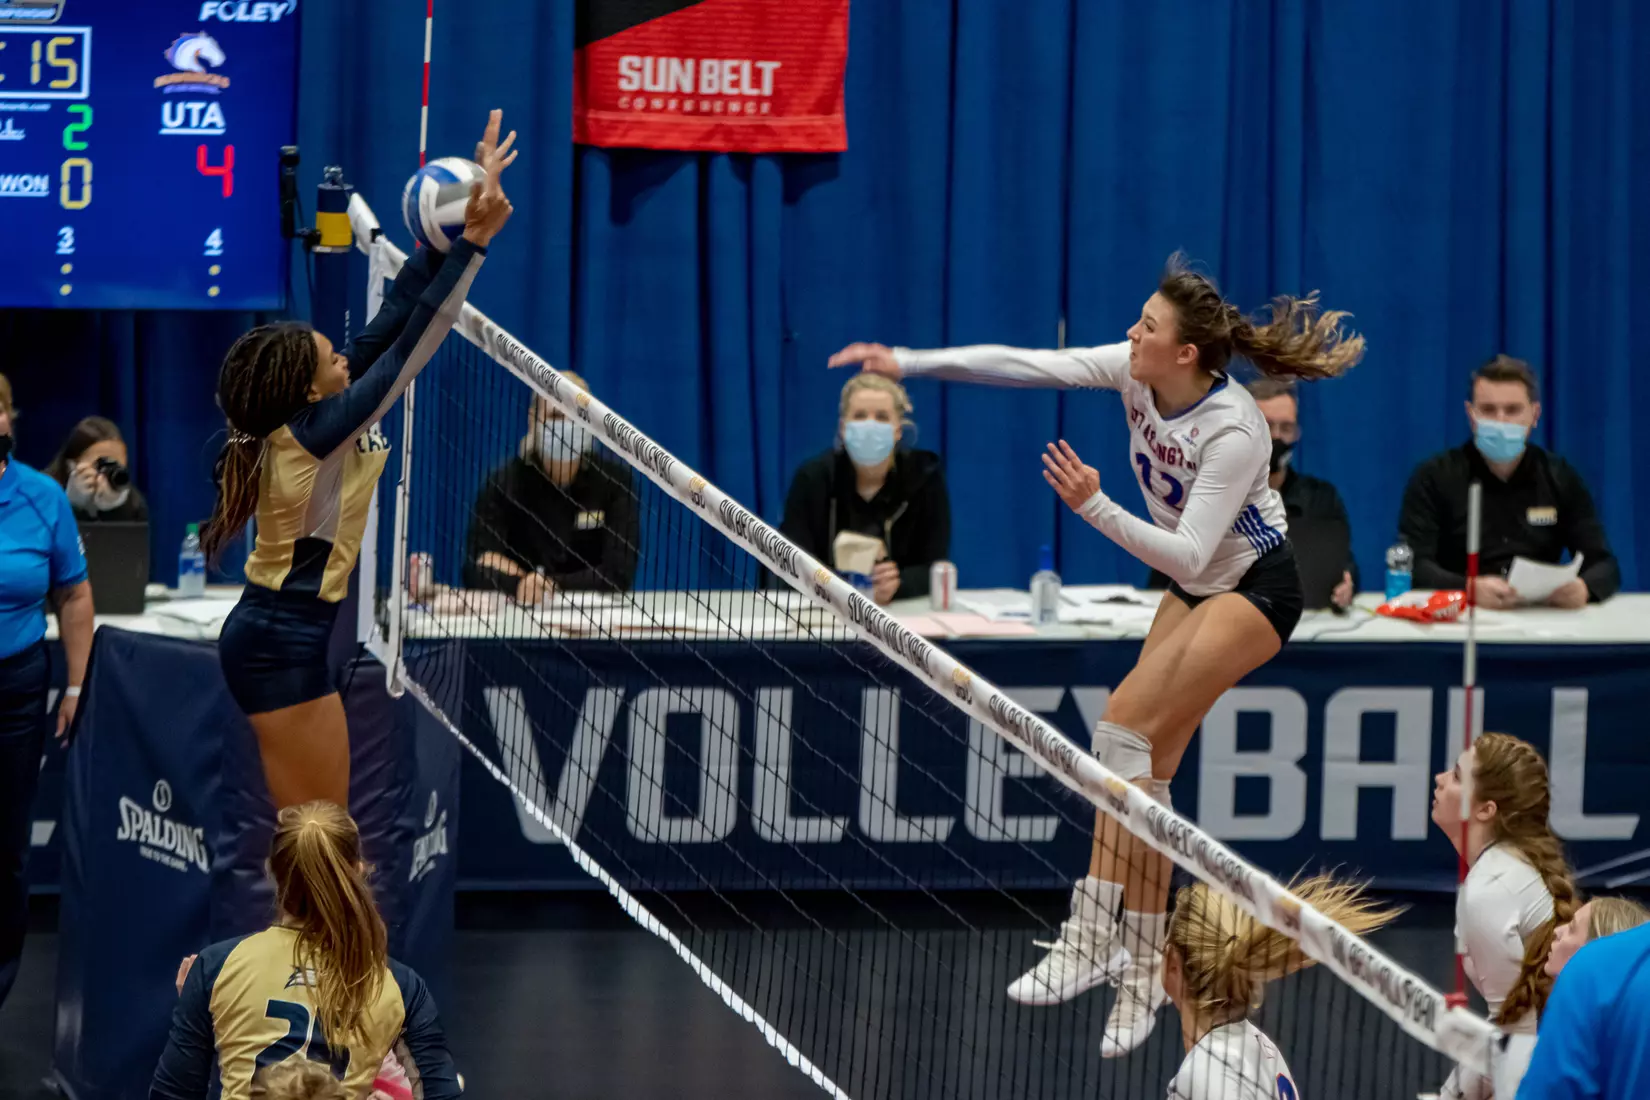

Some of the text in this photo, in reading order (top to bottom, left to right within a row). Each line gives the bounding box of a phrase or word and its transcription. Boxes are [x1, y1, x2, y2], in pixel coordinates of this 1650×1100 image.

[198, 1, 289, 22] FOLEY
[31, 37, 78, 89] 15
[618, 55, 782, 97] SUN BELT
[161, 101, 227, 129] UTA
[617, 96, 772, 115] CONFERENCE
[63, 104, 93, 151] 2
[60, 158, 93, 209] 0
[196, 144, 235, 198] 4
[57, 226, 75, 247] 3
[205, 228, 223, 249] 4
[117, 795, 210, 875] SPALDING
